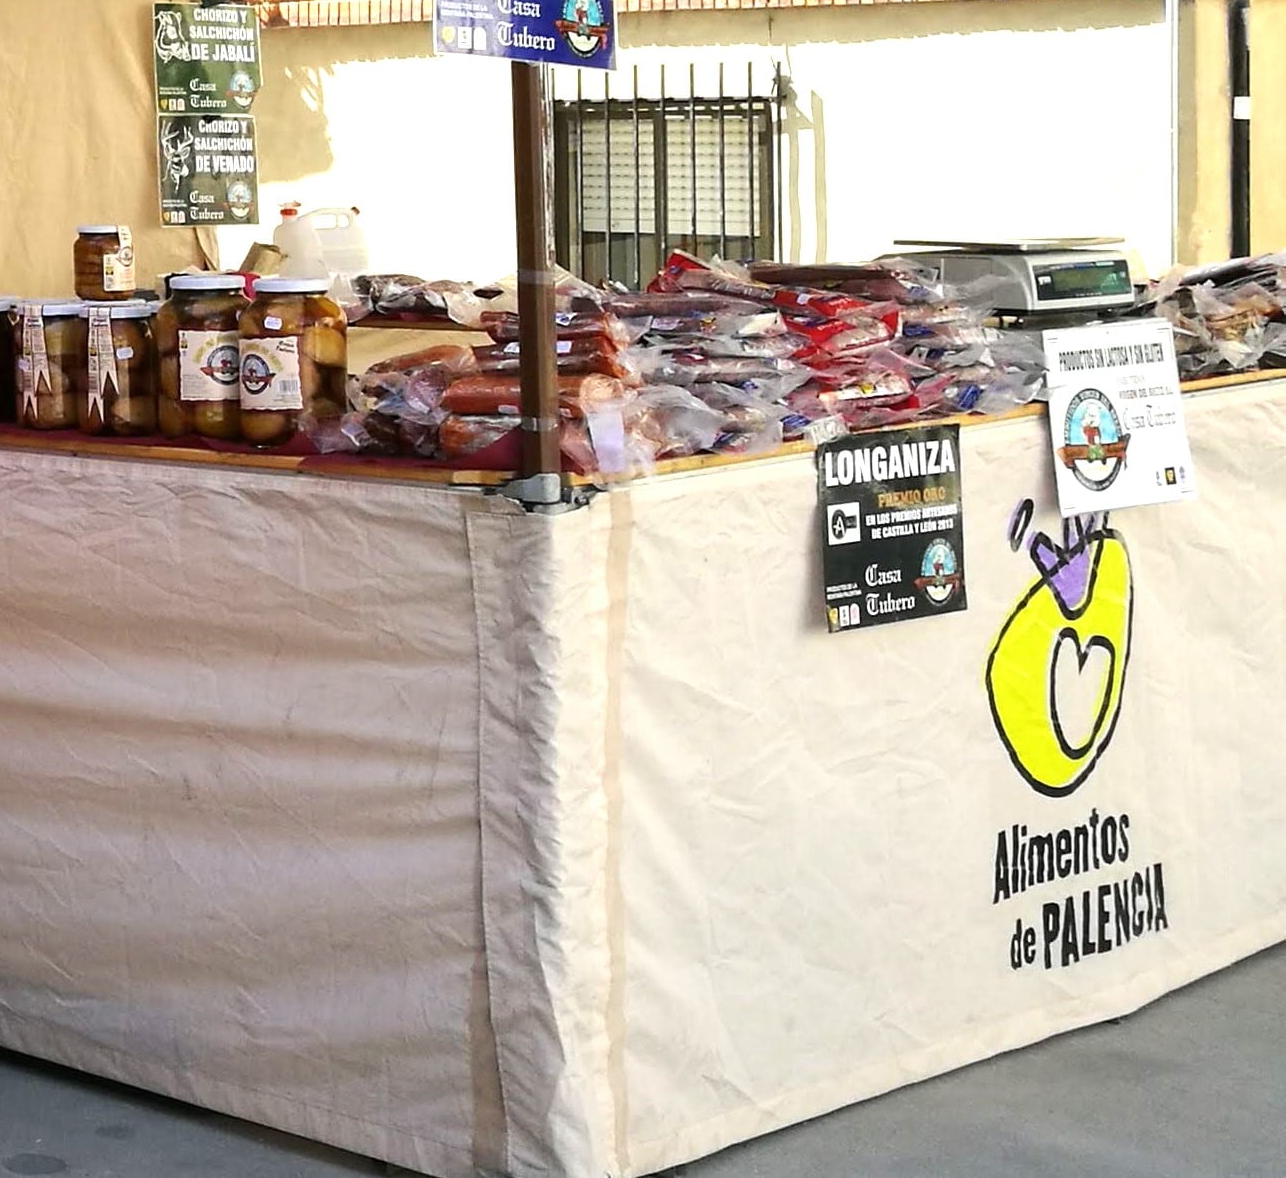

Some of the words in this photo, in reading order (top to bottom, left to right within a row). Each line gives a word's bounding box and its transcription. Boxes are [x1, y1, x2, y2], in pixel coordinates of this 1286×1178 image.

[193, 8, 239, 22] CHORIZO
[240, 9, 248, 23] Y
[189, 23, 254, 41] SALCHICHÓN
[496, 21, 556, 51] Tubero
[191, 44, 209, 61] DE
[212, 41, 256, 63] JABALÍ
[189, 78, 217, 92] Casa
[198, 119, 239, 134] CHORIZO
[240, 120, 248, 133] Y
[194, 136, 253, 151] SALCHICHÓN
[195, 155, 211, 173] DE
[212, 154, 254, 173] VENADO
[189, 190, 215, 203] Casa
[825, 439, 956, 487] LONGANIZA
[878, 489, 921, 508] PREMIO
[923, 486, 946, 502] ORO
[876, 512, 890, 525] LOS
[871, 527, 882, 540] DE
[882, 523, 914, 538] CASTILLA
[914, 523, 920, 534] Y
[865, 563, 902, 587] Casa
[865, 592, 916, 616] Tubero
[993, 807, 1130, 905] Alimentos
[1010, 918, 1036, 971] de
[1042, 862, 1169, 970] PALENCIA
